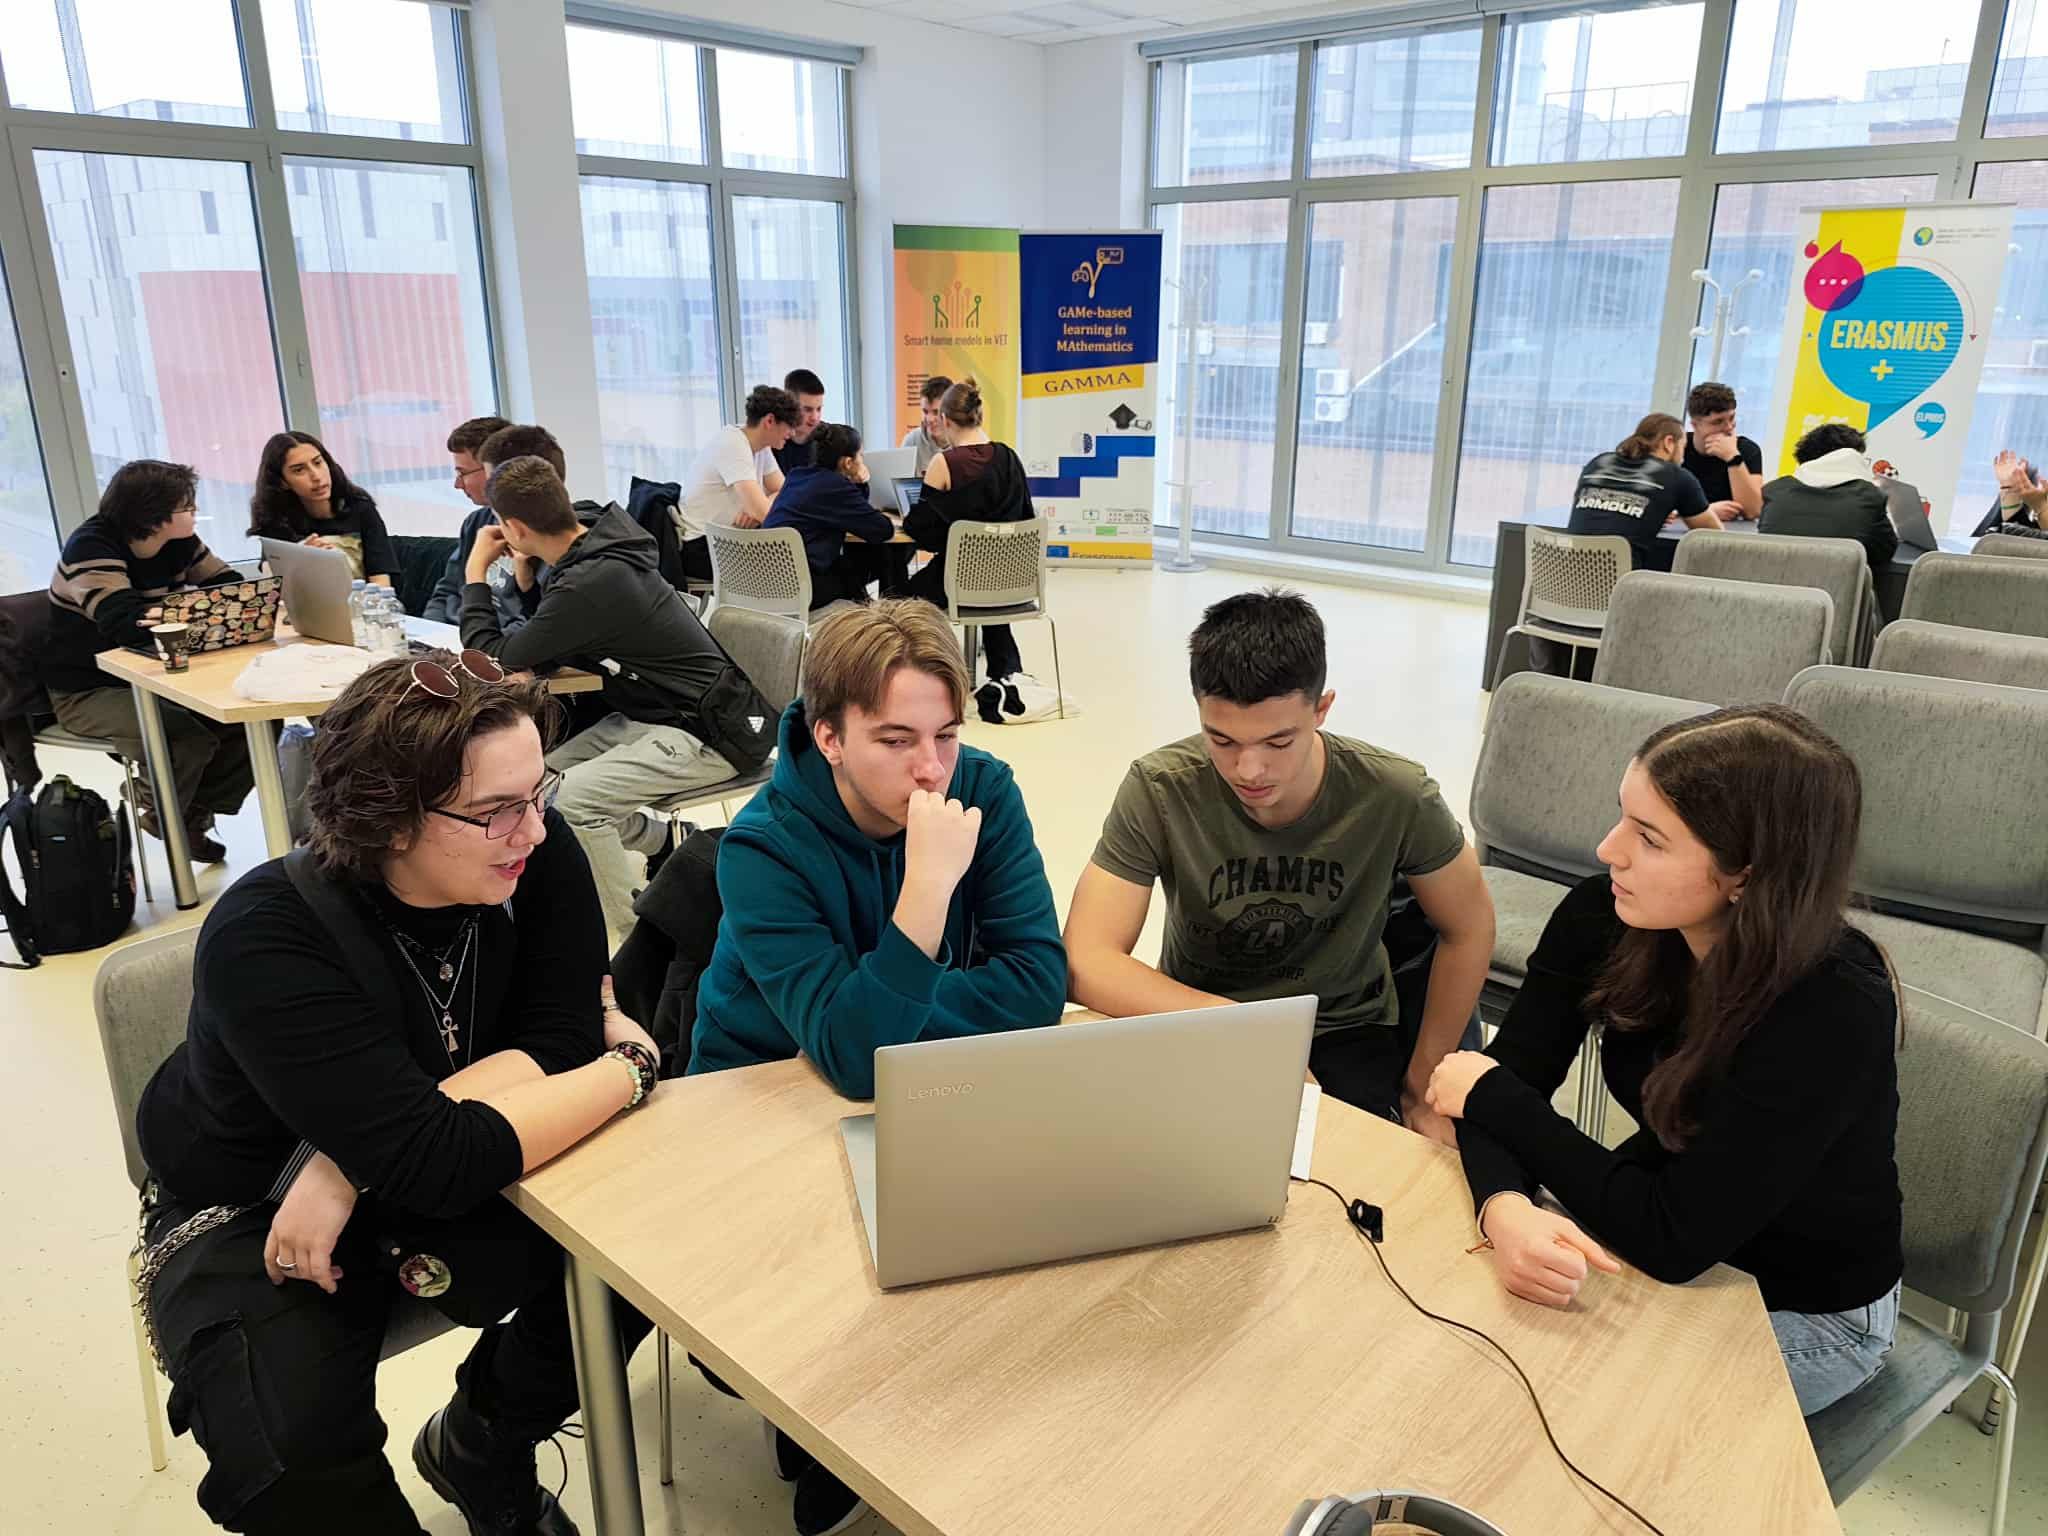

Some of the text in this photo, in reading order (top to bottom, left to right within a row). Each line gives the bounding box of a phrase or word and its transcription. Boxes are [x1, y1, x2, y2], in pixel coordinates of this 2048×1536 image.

[1058, 306, 1132, 318] GAMe-based
[904, 333, 1008, 346] Smart home models in VET
[1063, 323, 1127, 336] learning in
[1830, 319, 1949, 352] ERASMUS
[1056, 340, 1133, 352] MAthematics
[1870, 358, 1894, 381] +
[1044, 371, 1132, 392] GAMMA
[1576, 497, 1644, 518] ARMOUR
[1207, 855, 1345, 909] CHAMPS
[906, 1081, 976, 1100] Lenovo
